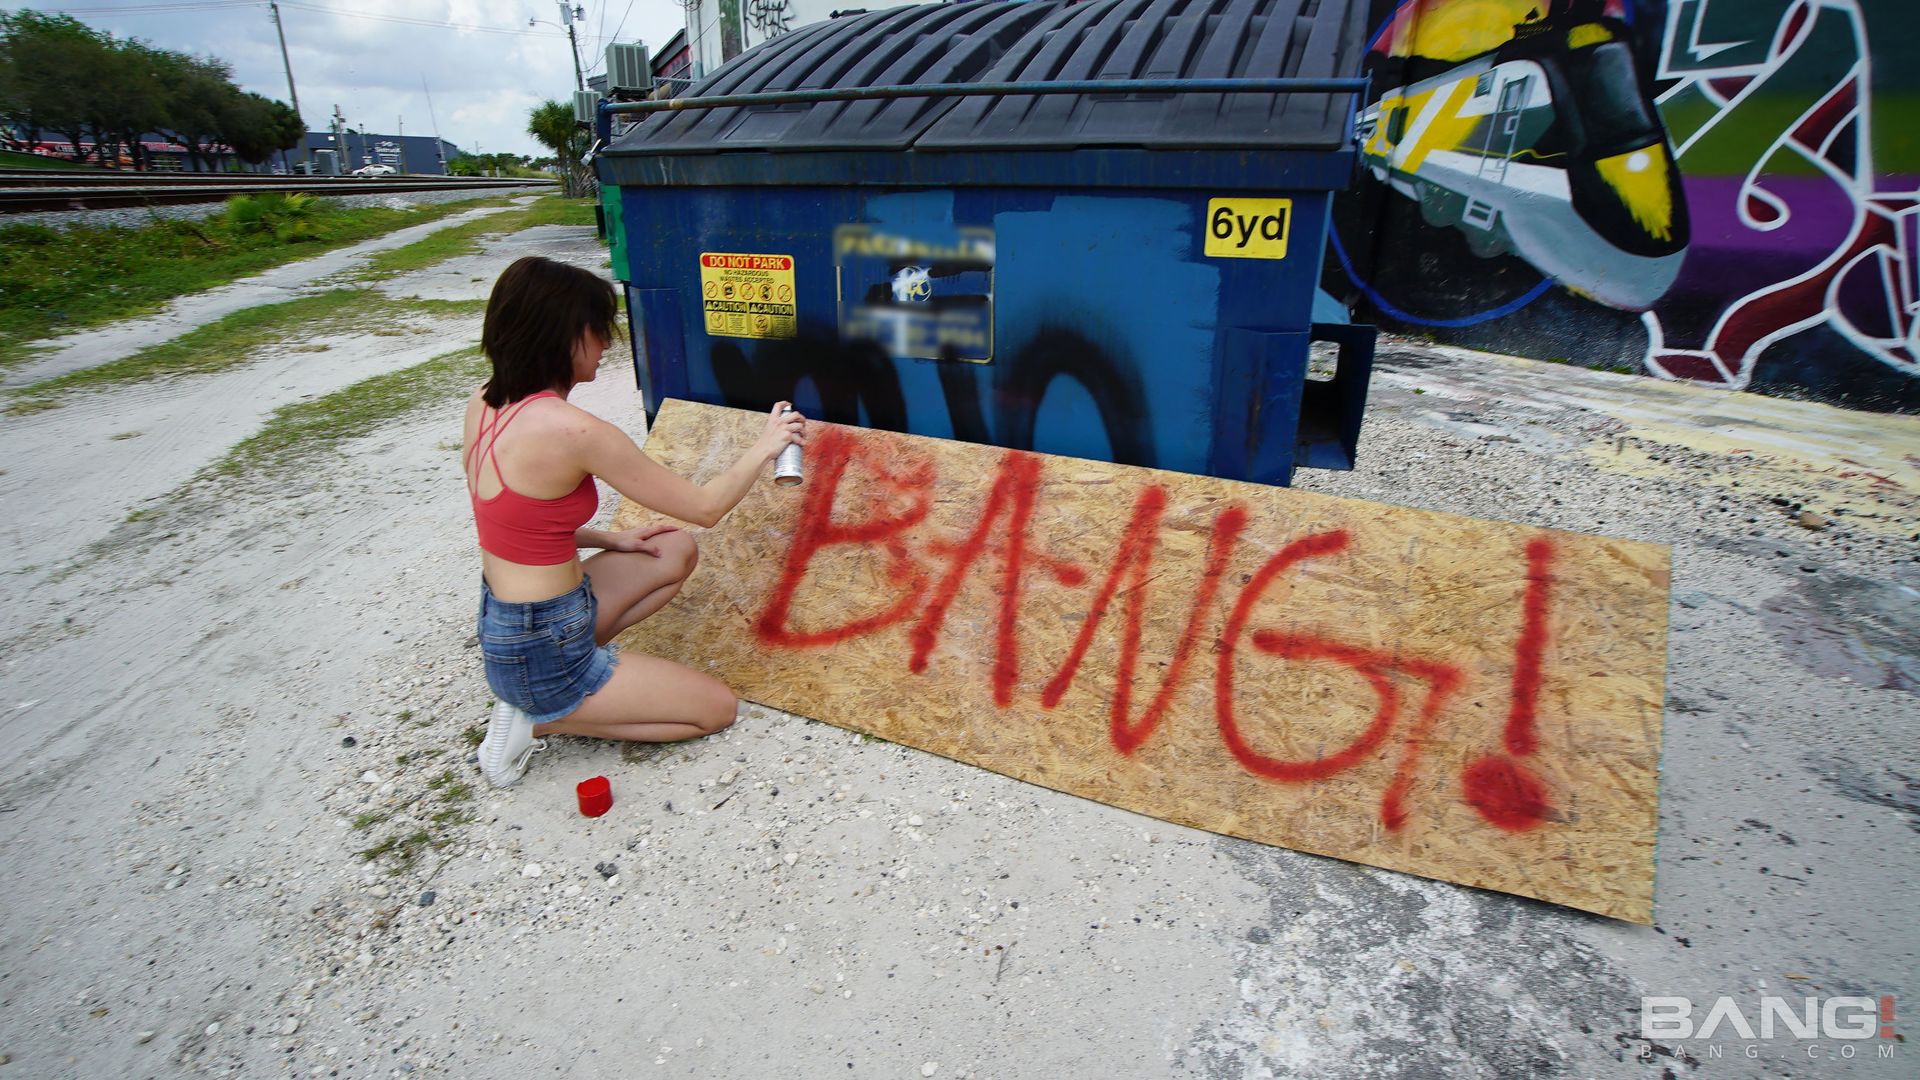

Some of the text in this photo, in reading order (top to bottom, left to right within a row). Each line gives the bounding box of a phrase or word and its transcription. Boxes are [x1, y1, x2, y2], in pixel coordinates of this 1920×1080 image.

[1212, 206, 1287, 248] 6yd
[709, 256, 785, 269] DO NOT PARK
[712, 301, 747, 312] CAUTION
[757, 303, 793, 315] CAUTION
